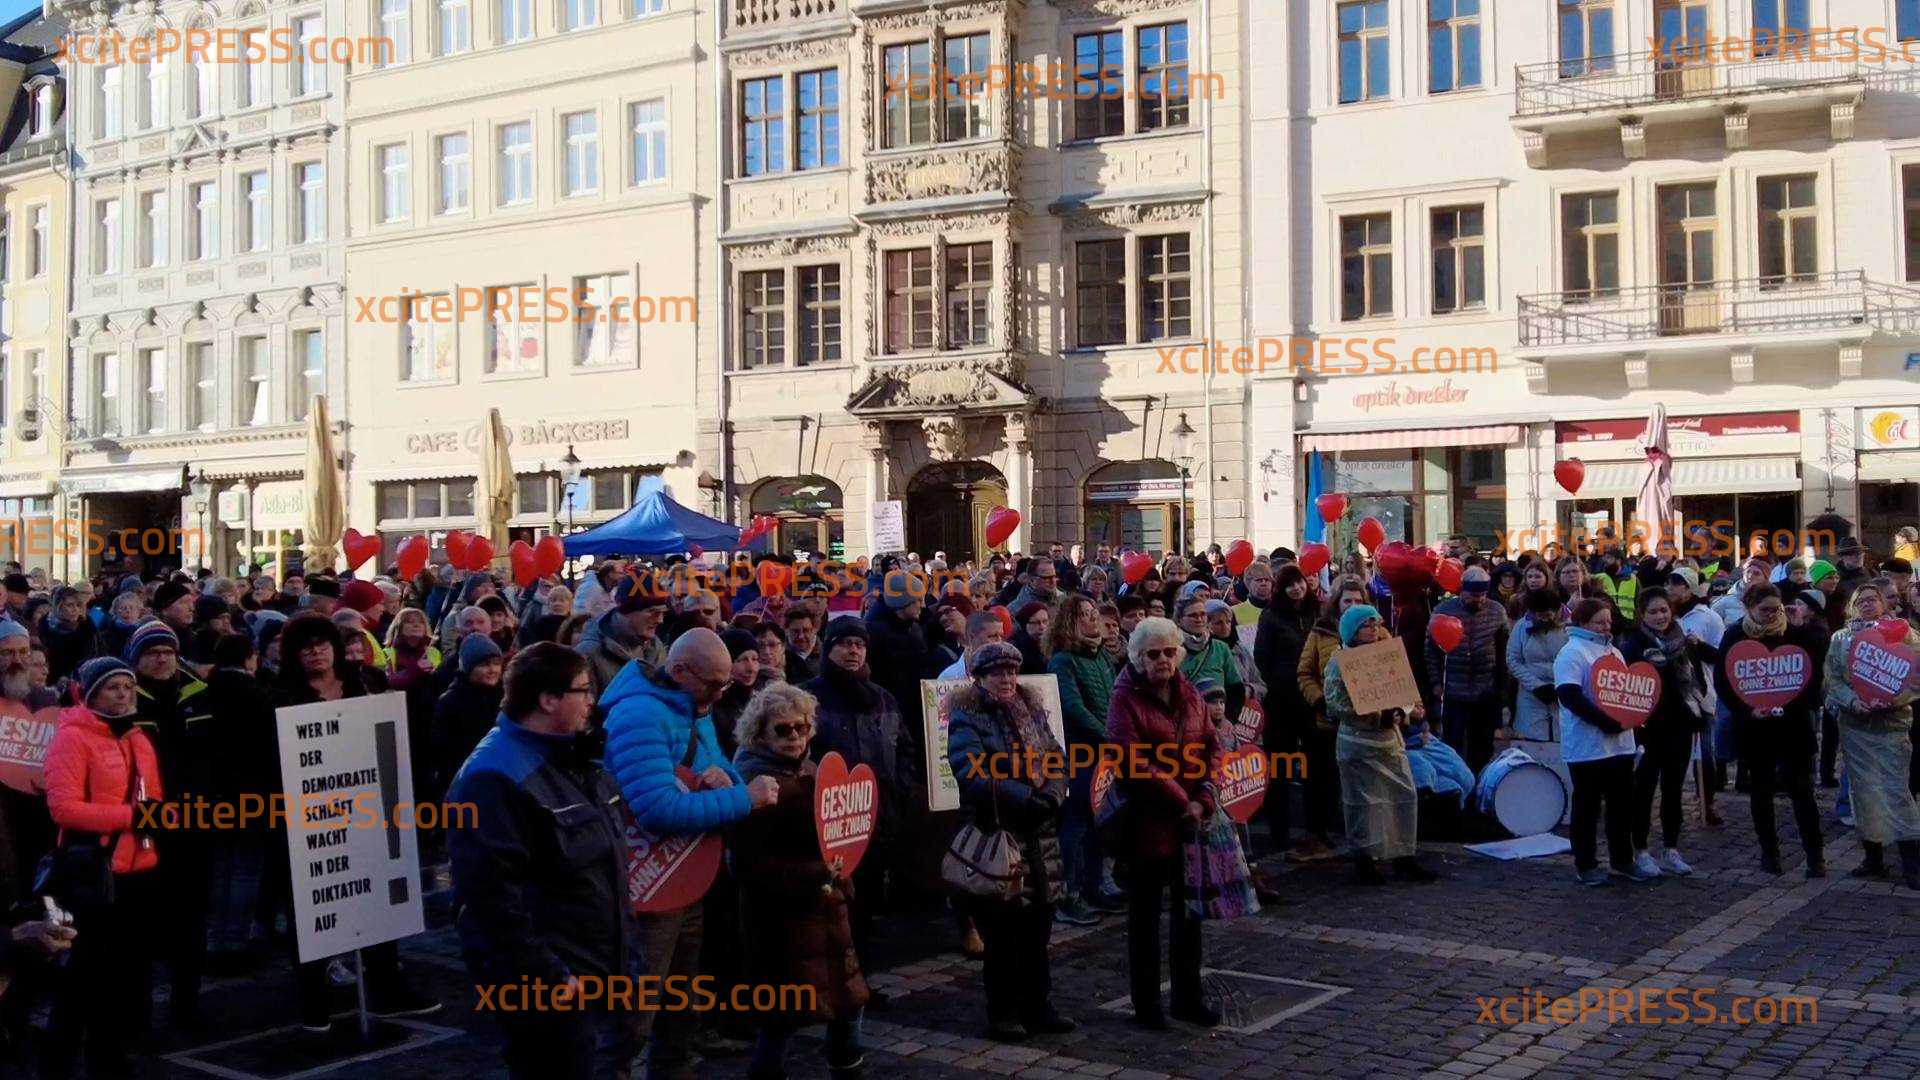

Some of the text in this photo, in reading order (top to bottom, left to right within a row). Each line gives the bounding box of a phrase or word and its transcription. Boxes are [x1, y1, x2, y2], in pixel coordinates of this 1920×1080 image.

[406, 418, 630, 454] CAFE BÄCKEREI
[1734, 653, 1804, 678] GESUND
[1854, 640, 1911, 680] GESUND
[1596, 668, 1656, 696] GESUND
[1739, 673, 1804, 691] OHNE ZWANG
[1598, 689, 1653, 709] OHNE ZWANG
[296, 718, 340, 740] WER IN
[299, 750, 323, 768] DER
[301, 768, 378, 795] DEMOKRATIE
[305, 799, 354, 823] SCHLÄFT
[820, 779, 874, 821] GESUND
[823, 812, 872, 842] OHNE ZWANG
[306, 828, 348, 851] WACHT
[309, 855, 350, 878] IN DER
[312, 877, 372, 906] DIKTATUR
[314, 912, 338, 933] AUF
